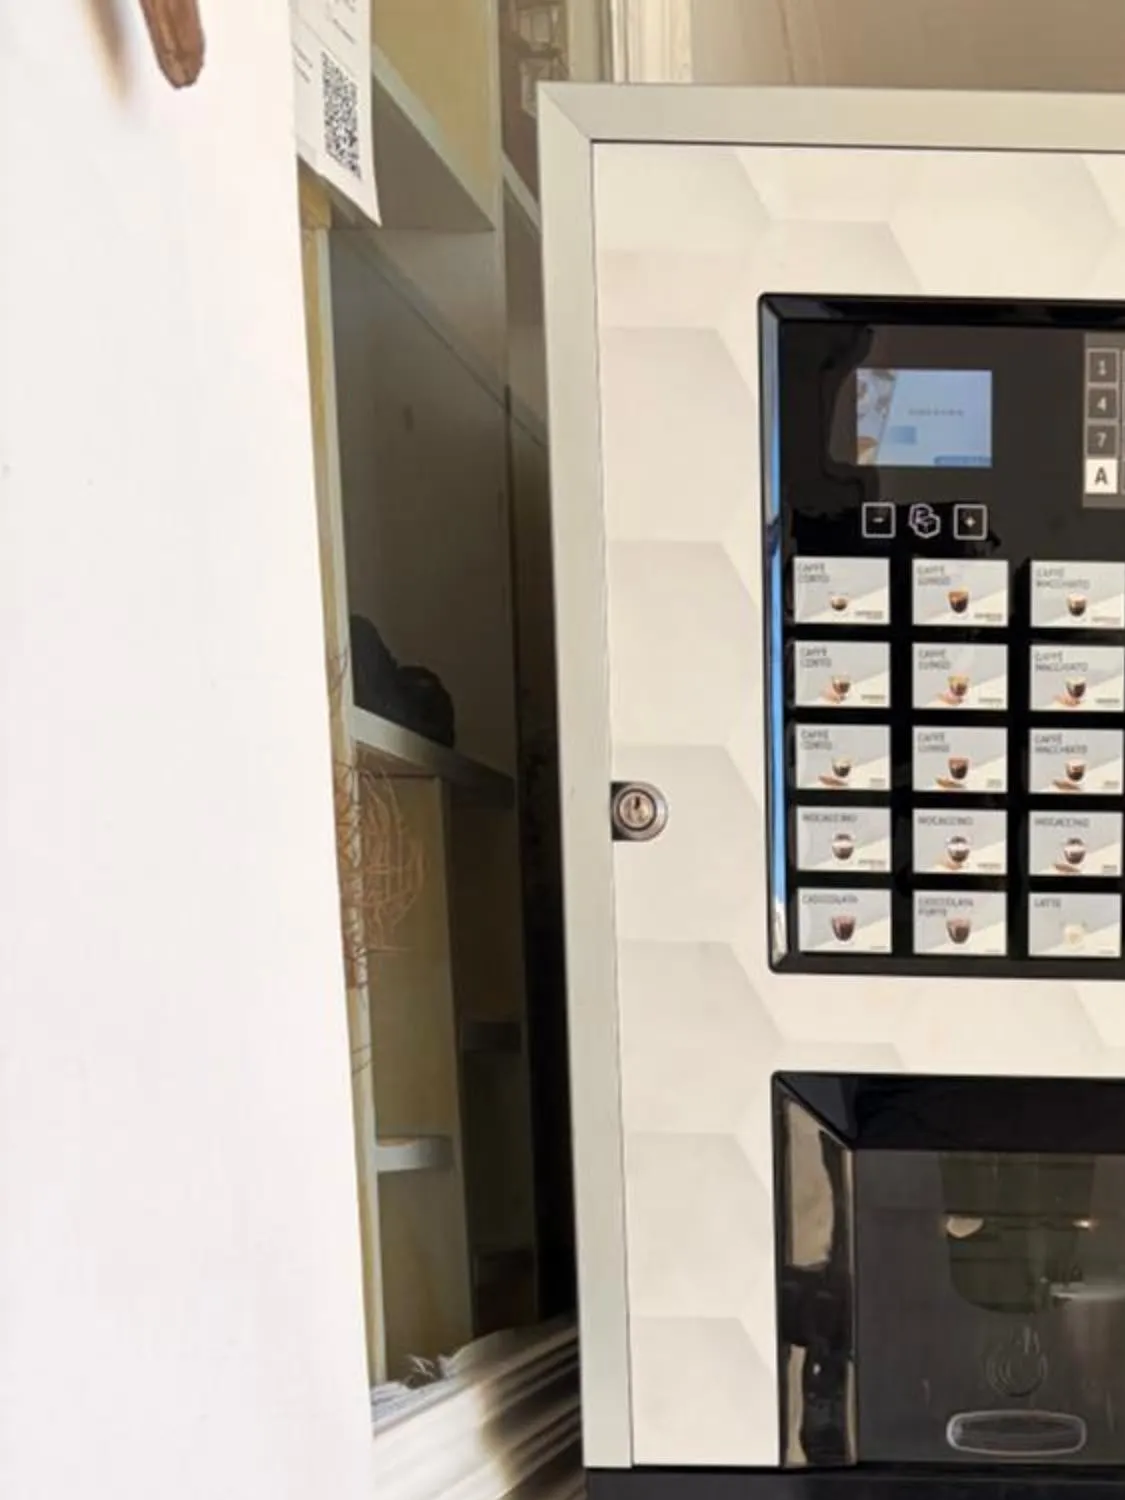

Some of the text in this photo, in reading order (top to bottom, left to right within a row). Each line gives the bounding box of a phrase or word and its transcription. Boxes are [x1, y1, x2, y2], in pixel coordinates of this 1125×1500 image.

[1097, 397, 1107, 411] 4
[1097, 432, 1107, 448] 7
[1094, 466, 1108, 485] A
[1034, 898, 1061, 908] LATTE
